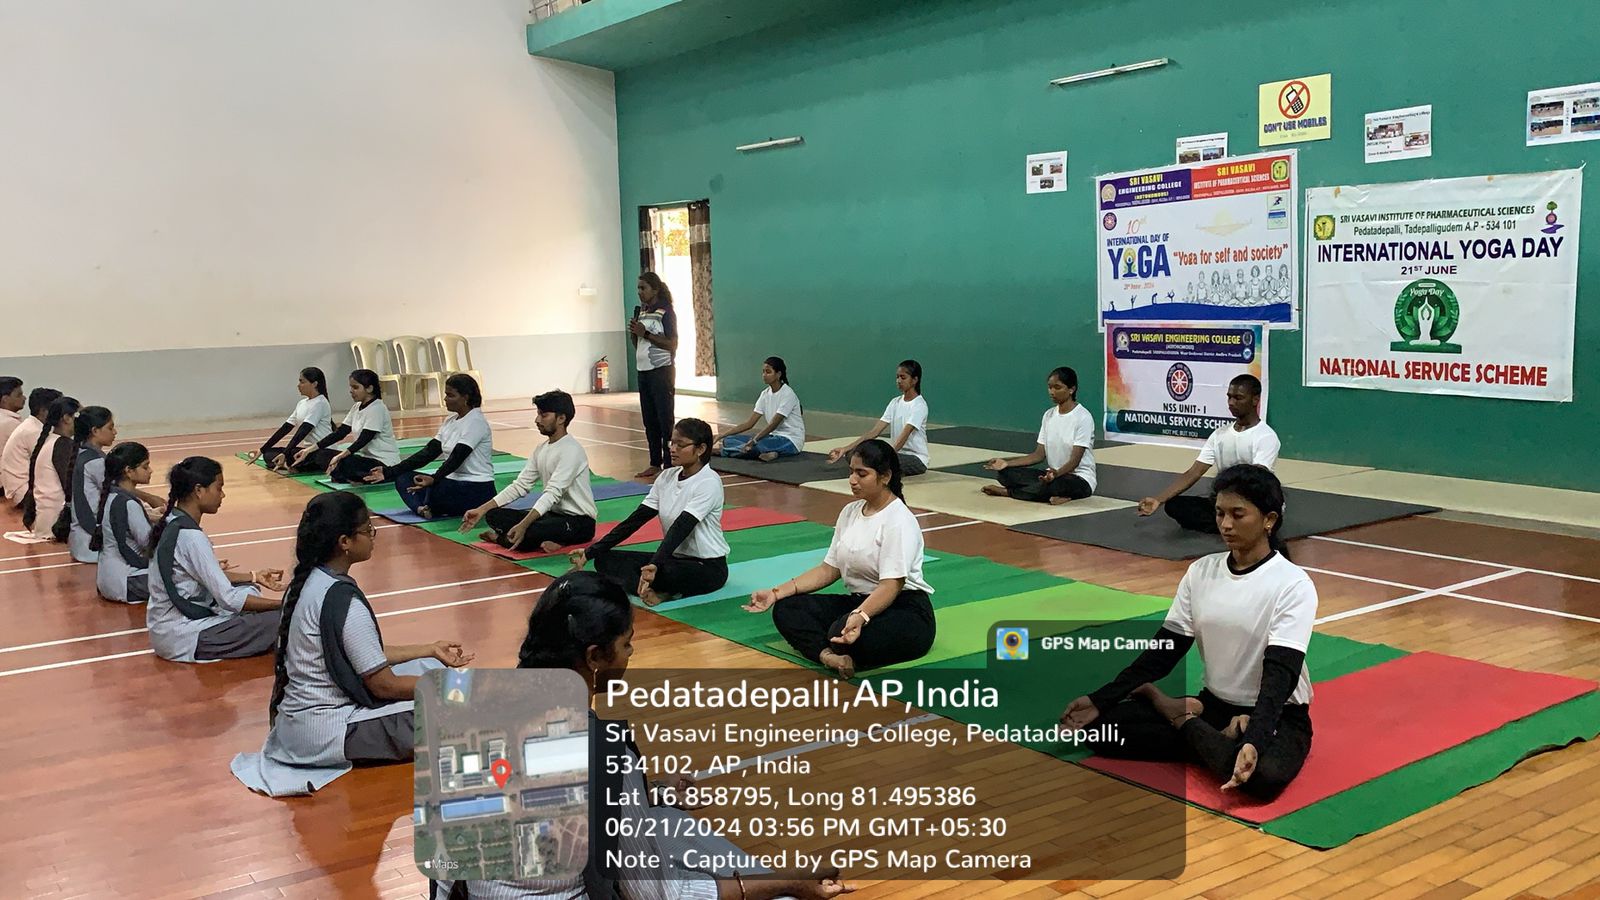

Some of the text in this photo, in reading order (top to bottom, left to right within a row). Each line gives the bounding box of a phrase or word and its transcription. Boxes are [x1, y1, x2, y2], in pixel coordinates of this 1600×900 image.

[1264, 116, 1327, 133] DON'T USE MOBILES
[1217, 163, 1256, 177] SRI VASAVI
[1129, 174, 1163, 186] SRI VASAVI
[1118, 181, 1182, 195] ENGINEERING COLLEGE
[1340, 205, 1535, 223] SRI VASAVI INSTITUTE OF PHARMACEUTICAL SCIENCES
[1353, 225, 1403, 236] Pedatadepalli,
[1404, 222, 1463, 235] Tadepalligudem
[1464, 221, 1479, 231] A.P
[1486, 220, 1500, 231] 534
[1503, 220, 1516, 230] 101
[1107, 233, 1169, 247] INTERNATIONAL DAY OF
[1200, 249, 1213, 265] for
[1215, 247, 1230, 263] self
[1233, 245, 1248, 263] and
[1318, 237, 1564, 262] INTERNATIONAL YOGA DAY
[1107, 244, 1171, 280] YOGA
[1401, 265, 1457, 275] 21ST JUNE
[1410, 287, 1445, 297] Yoga Day
[1130, 333, 1241, 345] SRI VASAVI ENGINEERING COLLEGE
[1319, 357, 1548, 386] NATIONAL SERVICE SCHEME
[1163, 402, 1177, 412] NSS
[1124, 412, 1168, 425] NATIONAL
[1169, 416, 1202, 428] SERVICE
